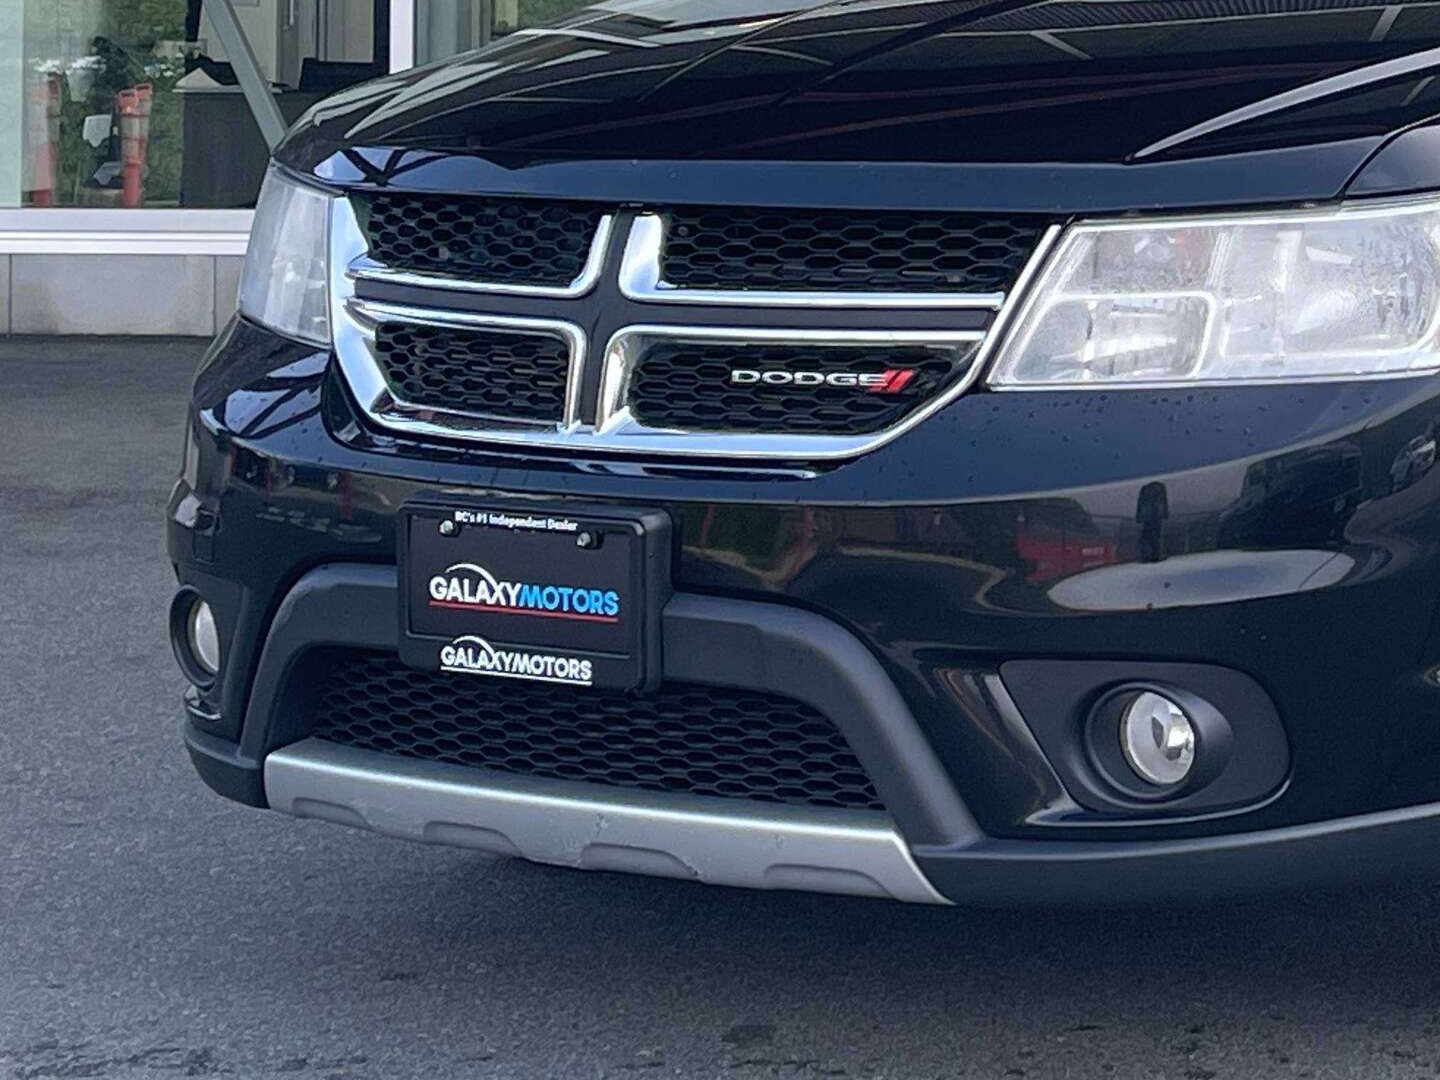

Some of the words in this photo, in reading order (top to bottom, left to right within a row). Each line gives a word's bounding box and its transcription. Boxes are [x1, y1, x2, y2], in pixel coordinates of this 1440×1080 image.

[731, 369, 888, 387] DODGE
[488, 513, 547, 529] Independent
[547, 518, 578, 531] Dealer
